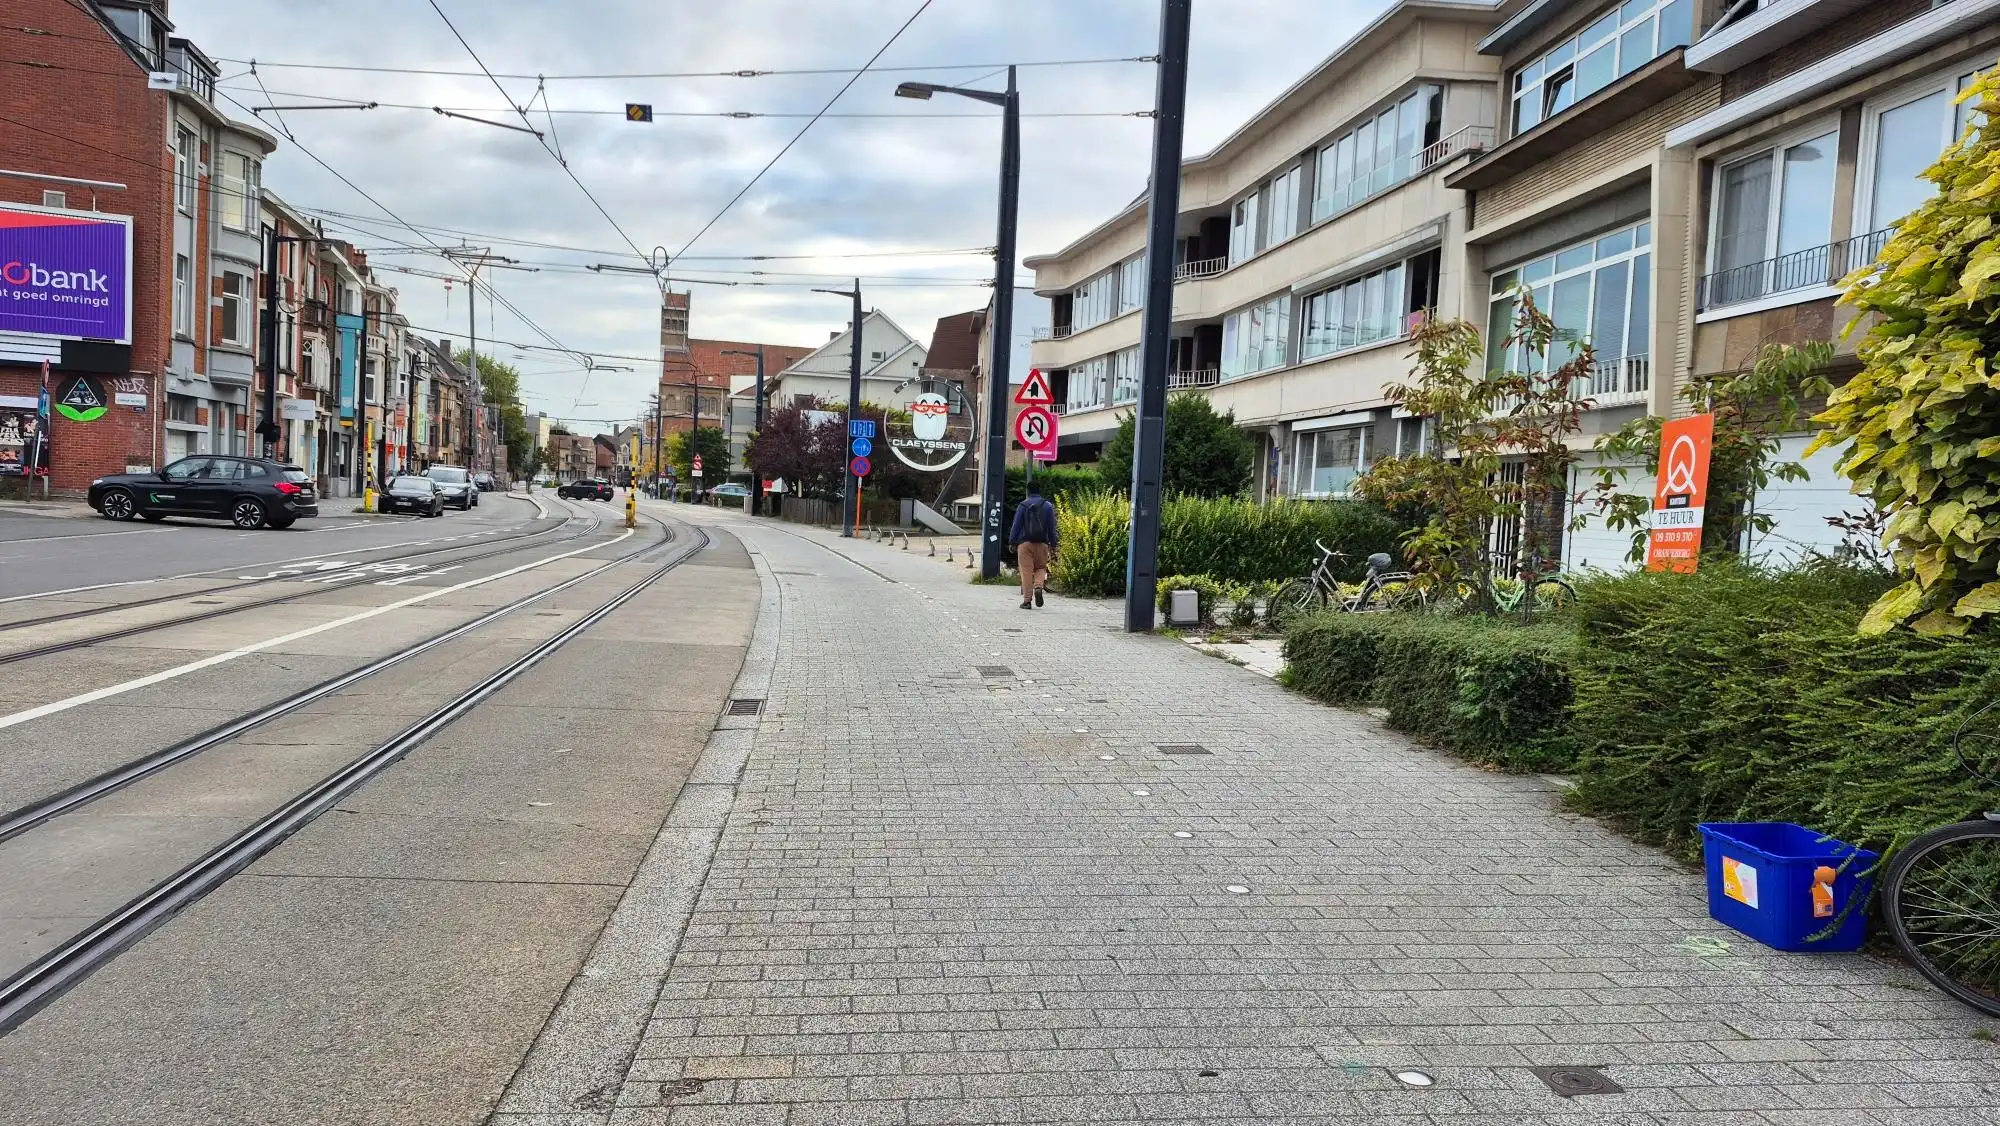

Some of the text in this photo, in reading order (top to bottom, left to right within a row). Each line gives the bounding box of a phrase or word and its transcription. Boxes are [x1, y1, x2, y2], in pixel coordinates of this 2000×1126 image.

[13, 290, 47, 300] goed
[52, 294, 109, 307] omringd
[892, 439, 965, 449] CLAEYSSENS
[1658, 511, 1694, 525] TE HUUR
[1656, 532, 1664, 542] 09
[1664, 532, 1675, 541] 310
[1682, 531, 1693, 542] 310
[238, 570, 431, 585] BUS
